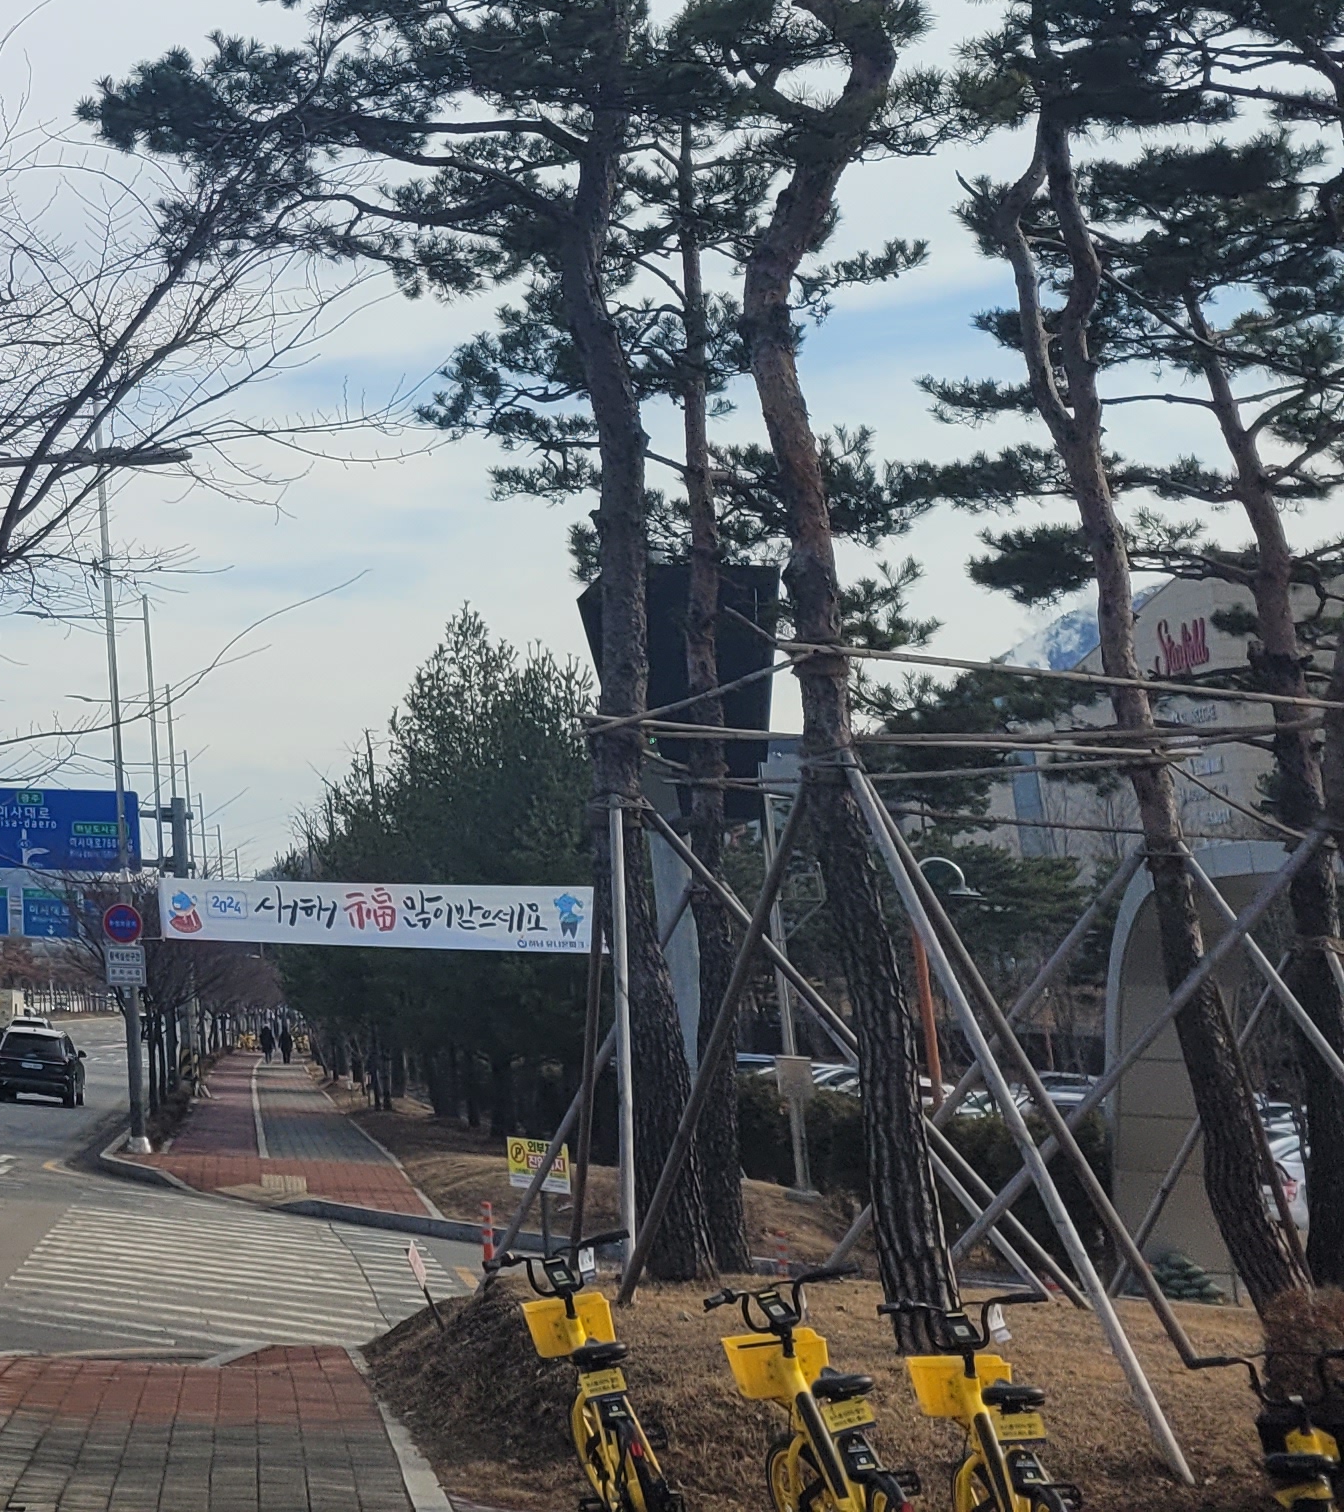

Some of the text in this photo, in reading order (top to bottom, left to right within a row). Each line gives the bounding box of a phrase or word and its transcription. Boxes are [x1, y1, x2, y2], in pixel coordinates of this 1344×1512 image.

[211, 895, 242, 914] 2024
[343, 887, 397, 932] 福
[527, 1141, 562, 1156] 외부
